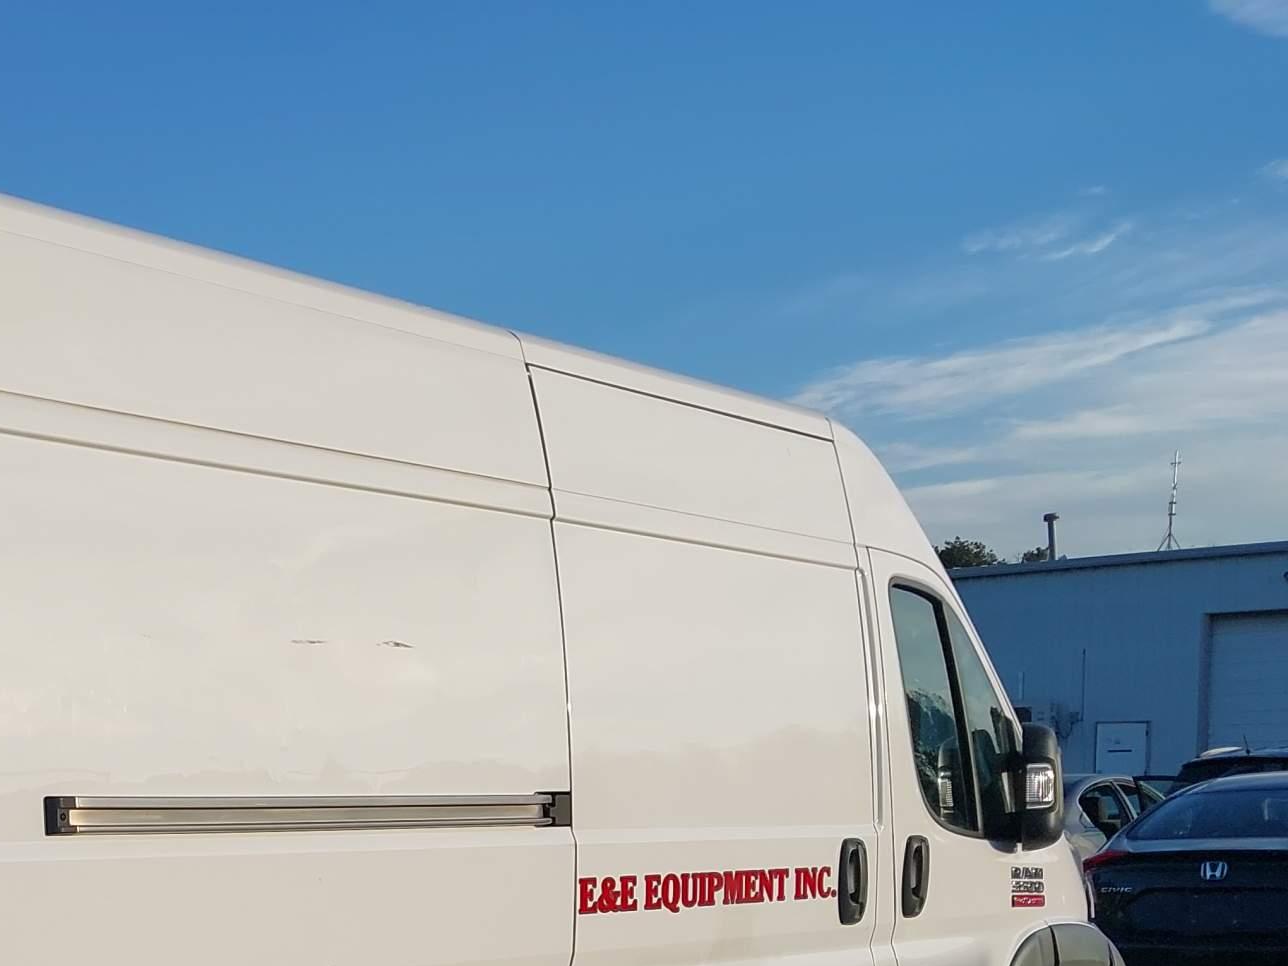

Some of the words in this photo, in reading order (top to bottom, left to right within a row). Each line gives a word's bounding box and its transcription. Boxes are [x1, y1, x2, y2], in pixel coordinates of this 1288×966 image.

[1011, 866, 1044, 879] RAM
[578, 875, 638, 914] E&E
[643, 868, 789, 913] EQUIPMENT
[794, 866, 837, 900] INC.
